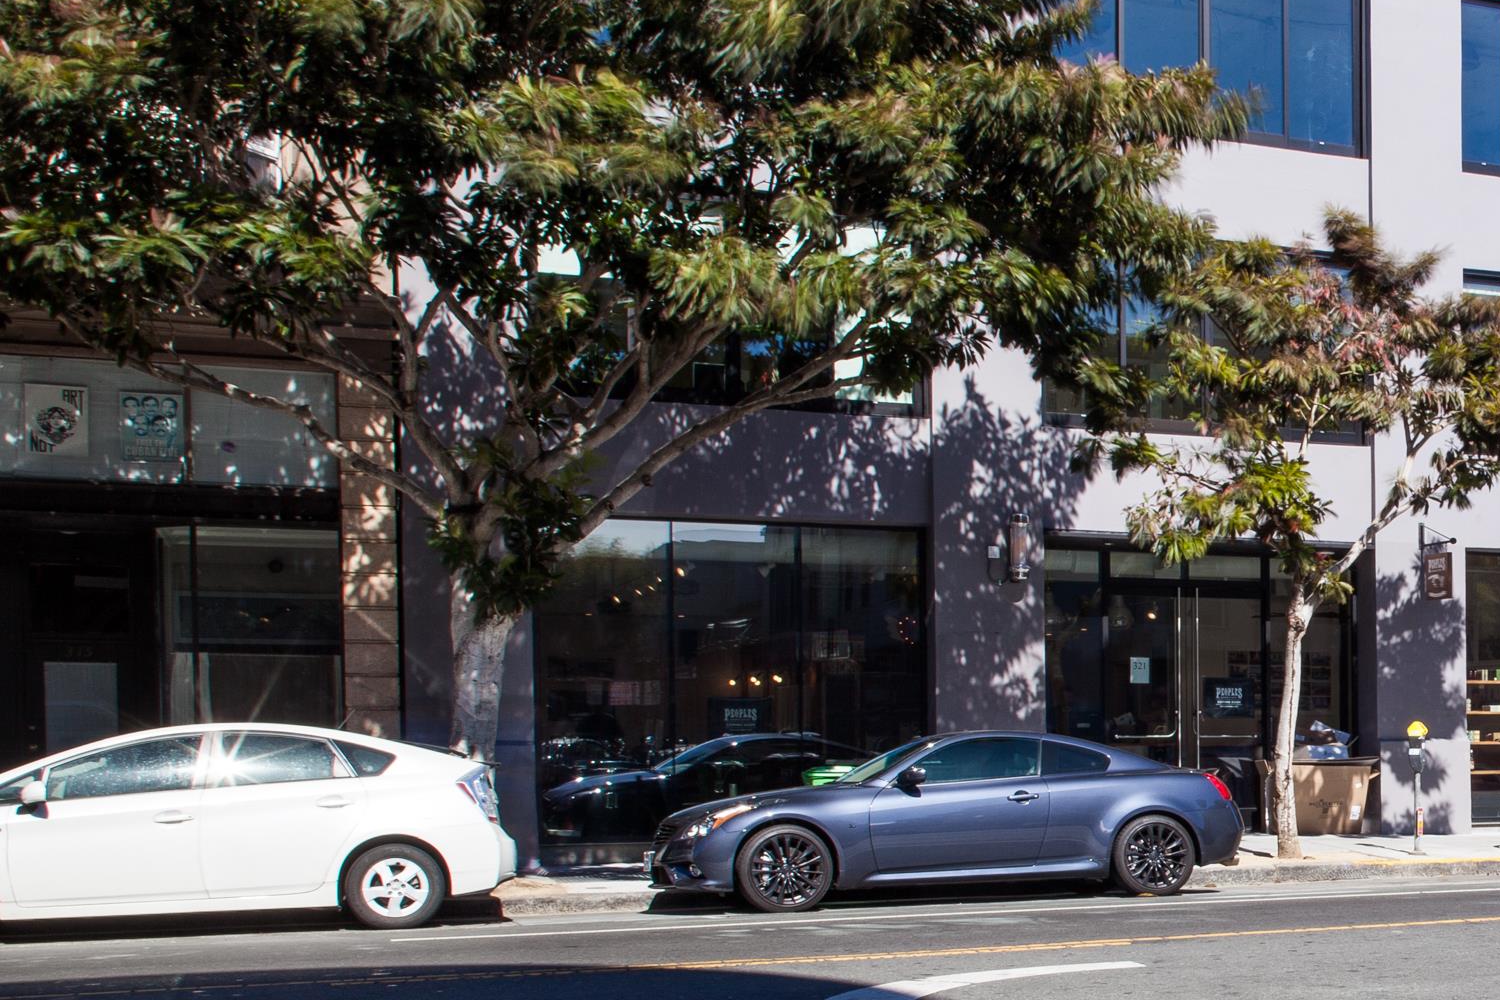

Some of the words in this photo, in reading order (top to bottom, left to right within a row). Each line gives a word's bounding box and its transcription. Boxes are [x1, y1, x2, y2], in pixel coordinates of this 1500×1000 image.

[63, 390, 85, 416] ART
[30, 430, 57, 453] NOT
[1133, 661, 1146, 671] 321
[1216, 687, 1242, 699] PEOPLES
[724, 708, 757, 721] PEOPLES
